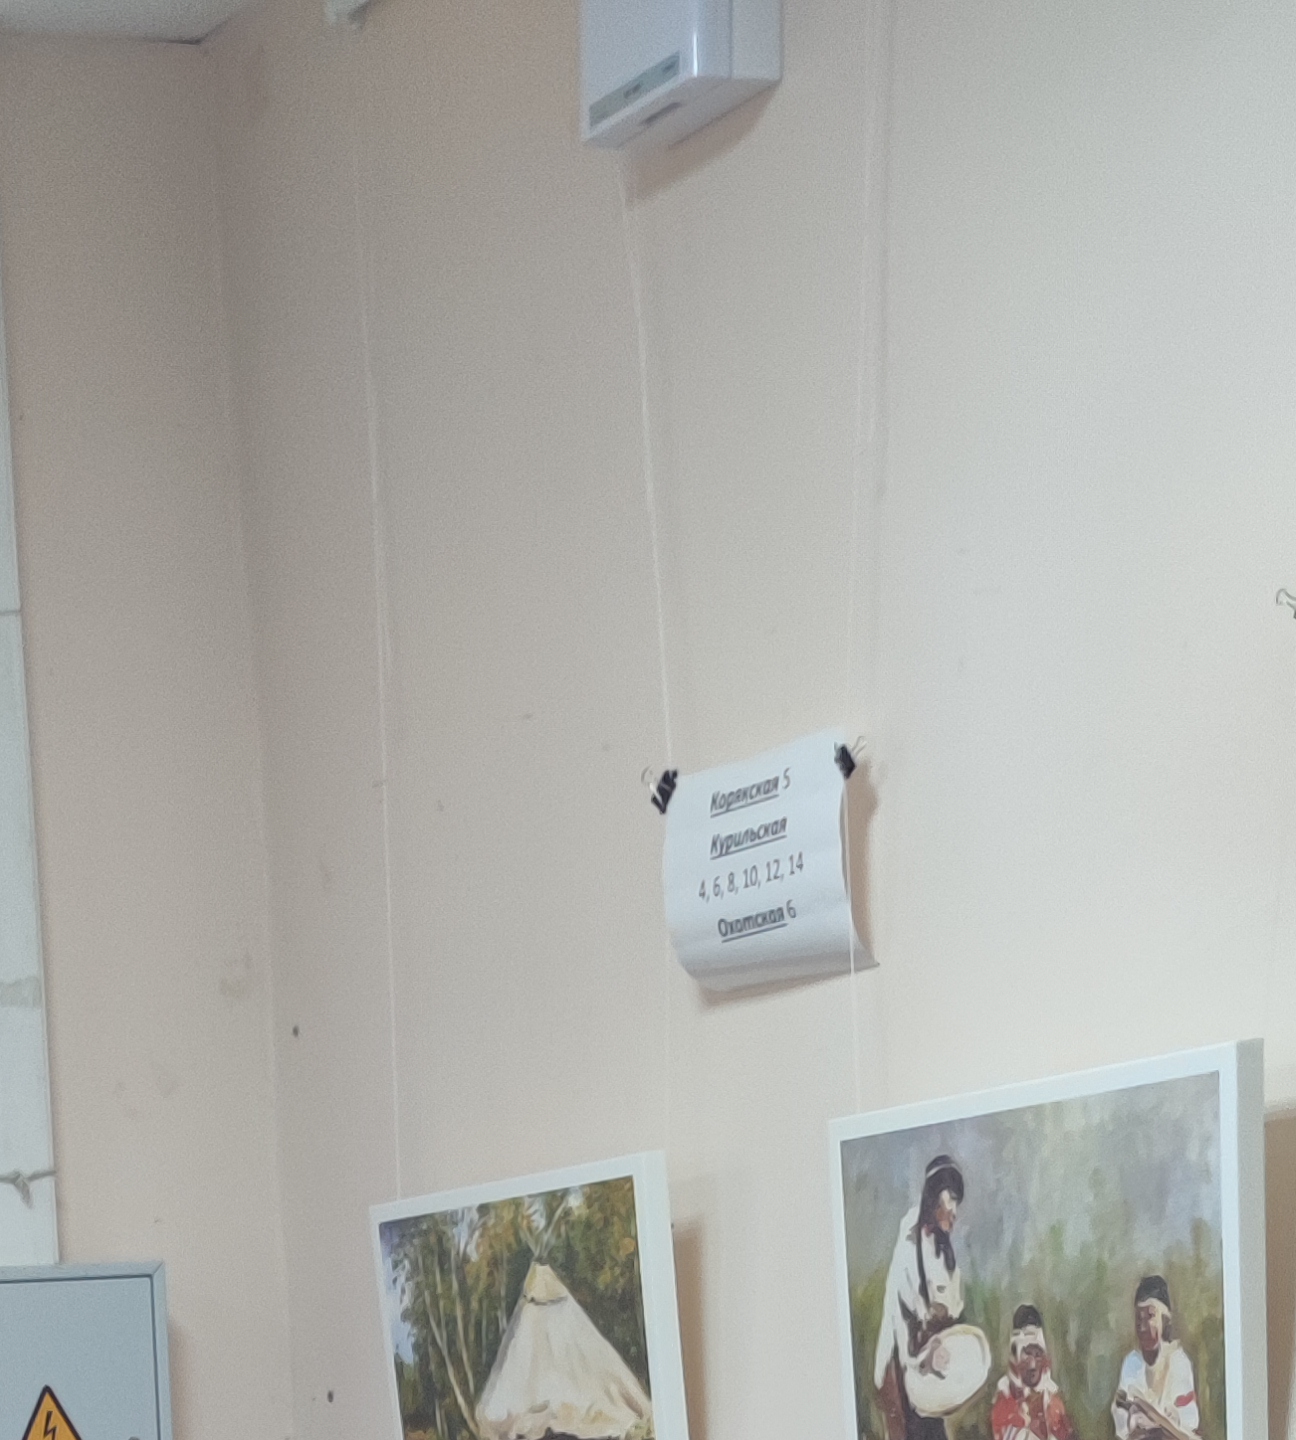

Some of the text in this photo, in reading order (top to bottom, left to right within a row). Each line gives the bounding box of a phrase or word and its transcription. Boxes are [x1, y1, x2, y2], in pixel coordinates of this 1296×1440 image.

[782, 767, 791, 789] 5
[710, 816, 787, 856] Курильская
[713, 876, 724, 900] 6,
[727, 871, 739, 895] 8,
[743, 865, 761, 889] 10,
[766, 859, 785, 883] 12,
[789, 852, 804, 875] 14
[718, 899, 797, 937] Охотская 6
